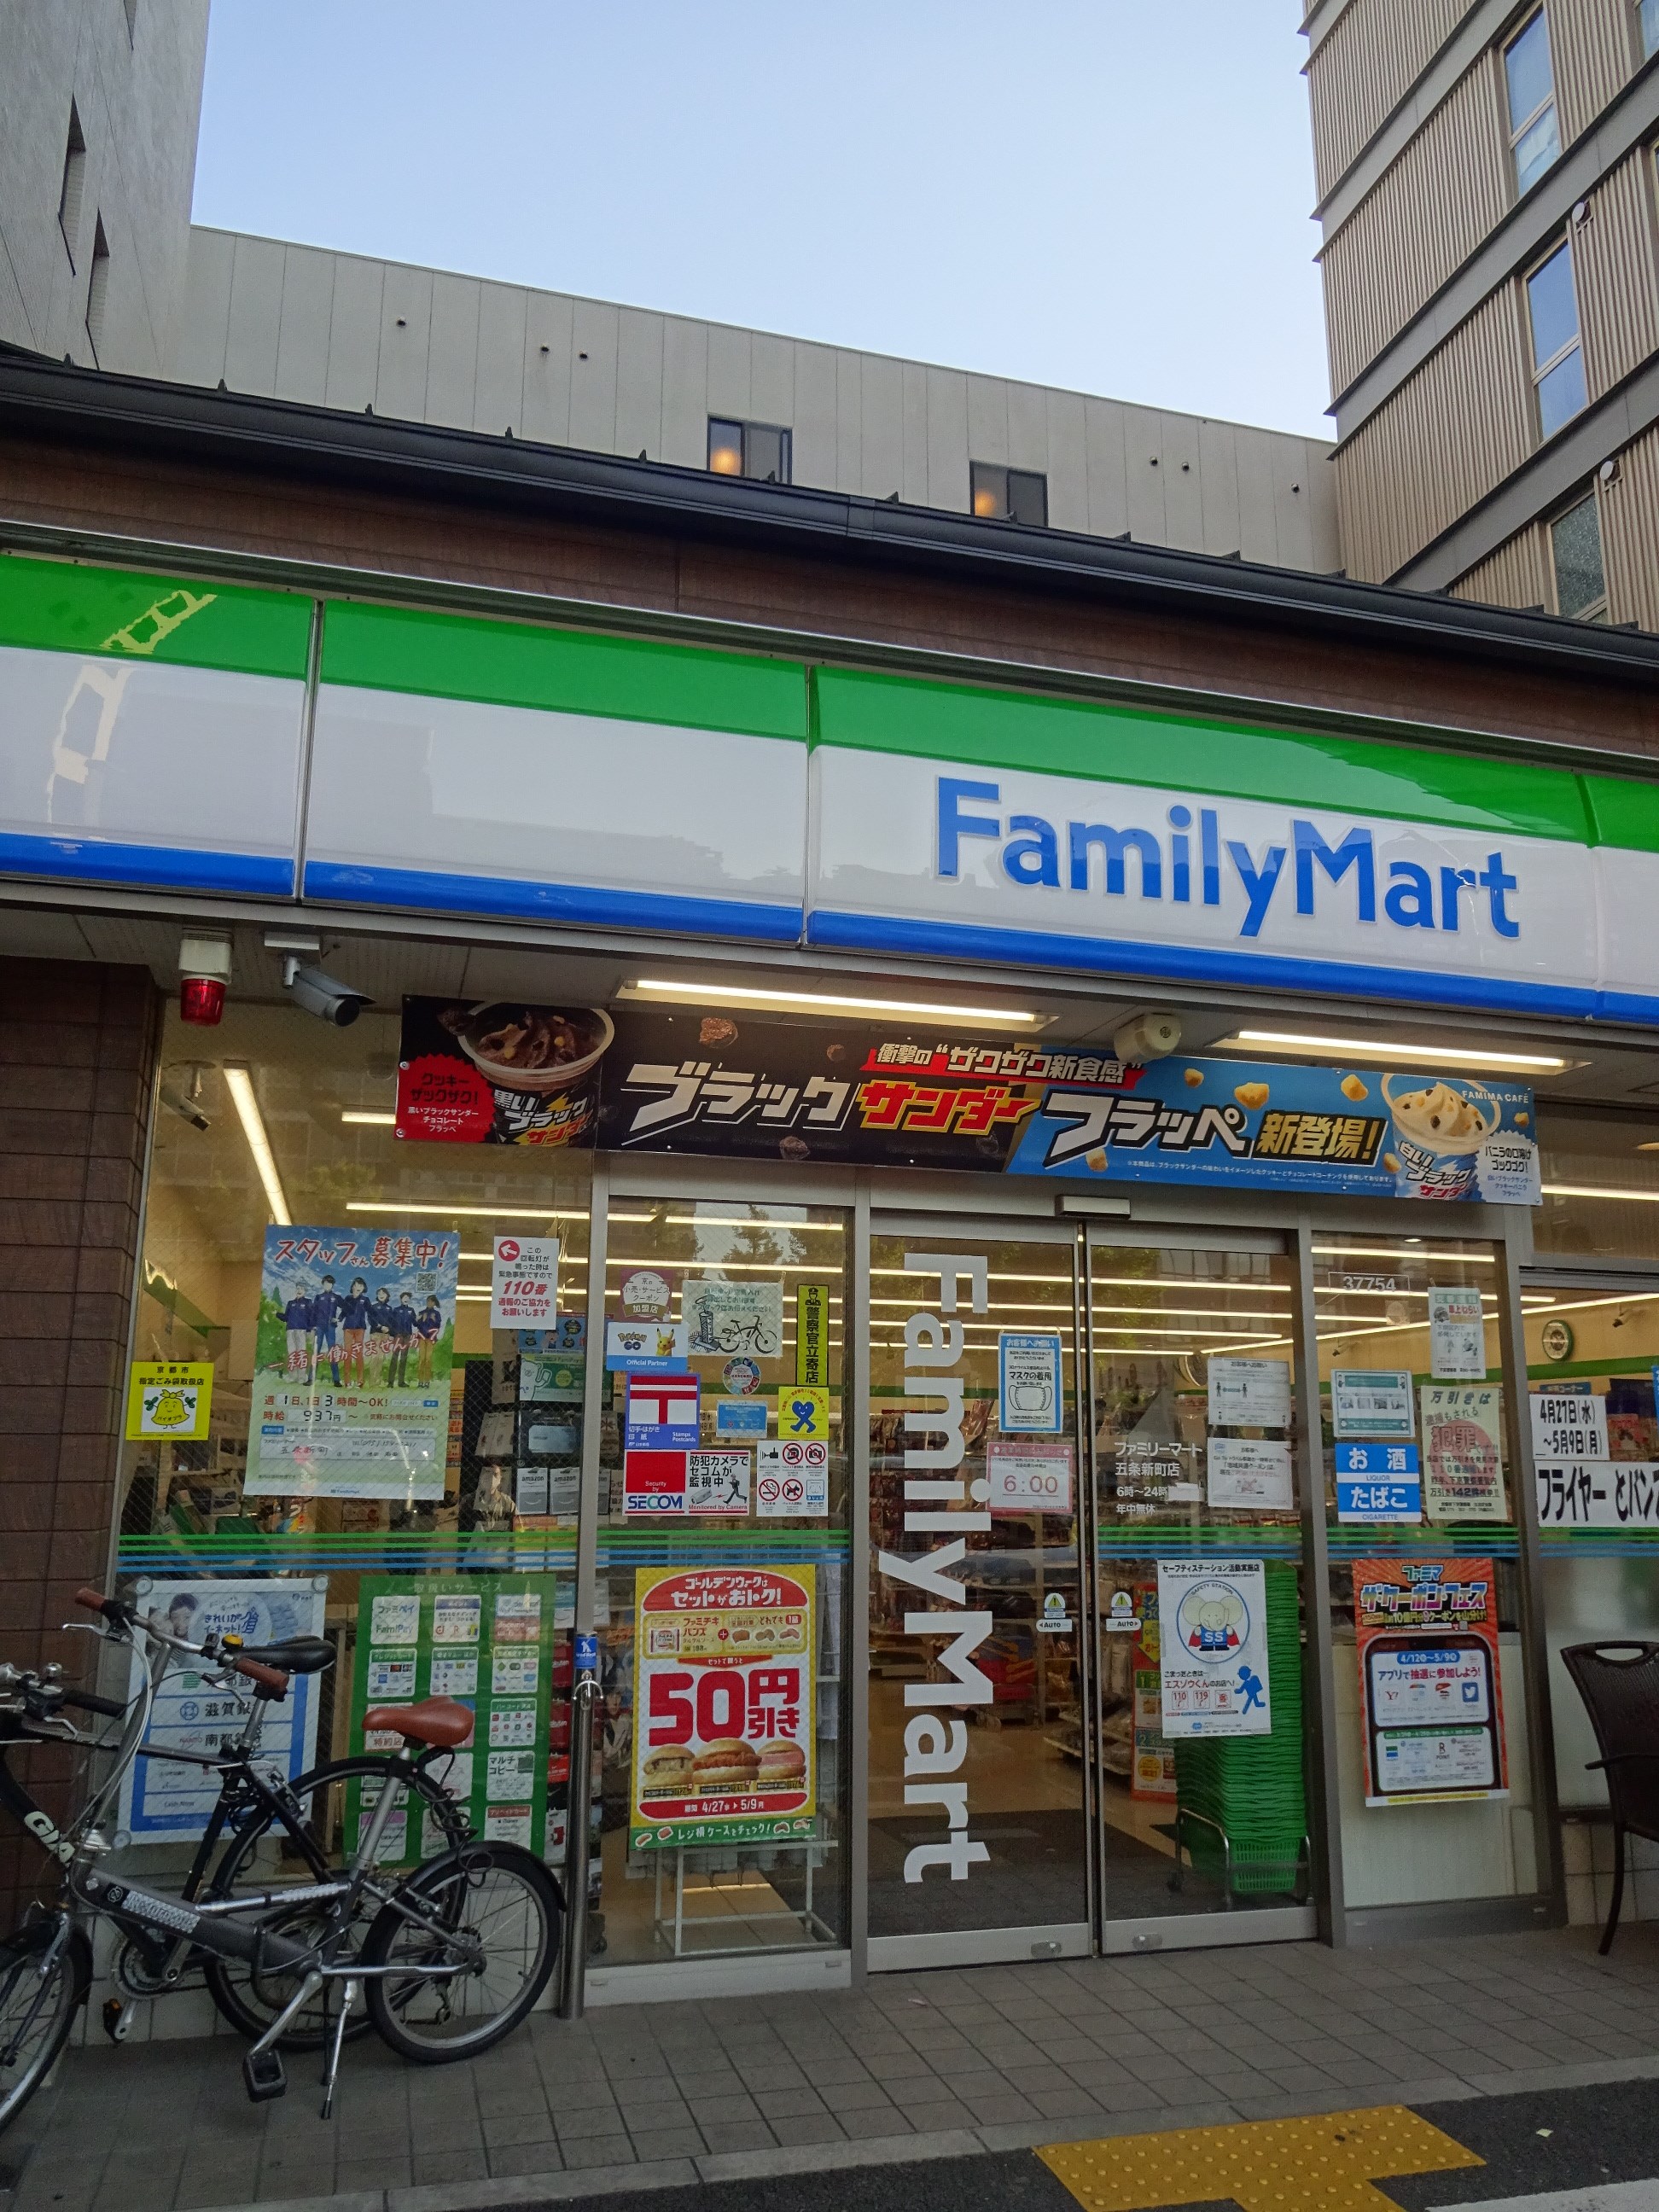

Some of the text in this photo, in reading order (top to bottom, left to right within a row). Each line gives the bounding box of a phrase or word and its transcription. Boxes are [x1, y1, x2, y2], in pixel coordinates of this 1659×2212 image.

[937, 776, 1520, 939] FamilyMart
[422, 1072, 469, 1086] クッキー
[410, 1088, 479, 1105] ザックザク!
[492, 1089, 536, 1110] 黒い
[1462, 1090, 1503, 1102] FAMIMA
[423, 1116, 463, 1126] チョコレート
[504, 1097, 586, 1132] ブラック
[621, 1061, 1383, 1167] ブラック サンダー フラッペ 新登場!
[1399, 1141, 1435, 1167] 白い
[1406, 1160, 1473, 1186] ブラック
[274, 1236, 451, 1269] スタッフさん募集中!
[498, 1271, 553, 1279] 緊急事態ですので
[503, 1281, 549, 1295] 110番
[1342, 1275, 1397, 1292] 37754
[498, 1298, 551, 1307] 通報のご協力を
[633, 1294, 661, 1302] クーポン
[501, 1308, 548, 1317] お願いします
[632, 1305, 659, 1313] 加盟店
[623, 1341, 642, 1350] GO
[804, 1306, 821, 1384] 警察官立寄店
[1009, 1371, 1052, 1381] マスクの着用
[1431, 1390, 1492, 1405] 万引きは
[263, 1411, 285, 1422] 時給
[1540, 1399, 1596, 1424] 4月27日(水)
[1114, 1442, 1202, 1457] ファミリーマート
[690, 1455, 749, 1467] 防犯カメラで
[690, 1466, 732, 1476] セコムが
[1115, 1462, 1180, 1477] 五条新町店
[521, 1475, 544, 1483] amazon
[689, 1476, 725, 1487] 監視中
[1004, 1475, 1058, 1493] 6:00
[1351, 1486, 1408, 1510] たばこ
[1538, 1465, 1606, 1522] フライヤー
[627, 1494, 683, 1510] SECOM
[1115, 1503, 1156, 1515] 年中無休
[879, 1253, 993, 1883] FamilyMart
[1402, 1565, 1444, 1581] ファミマ
[377, 1604, 416, 1615] ファミペイ
[683, 1616, 720, 1627] ファミチキ
[683, 1627, 707, 1637] バンズ
[1204, 1632, 1224, 1643] SS
[1173, 1691, 1208, 1701] 110 119
[204, 1701, 255, 1718] 滋賀銀
[489, 1756, 515, 1765] マルチ
